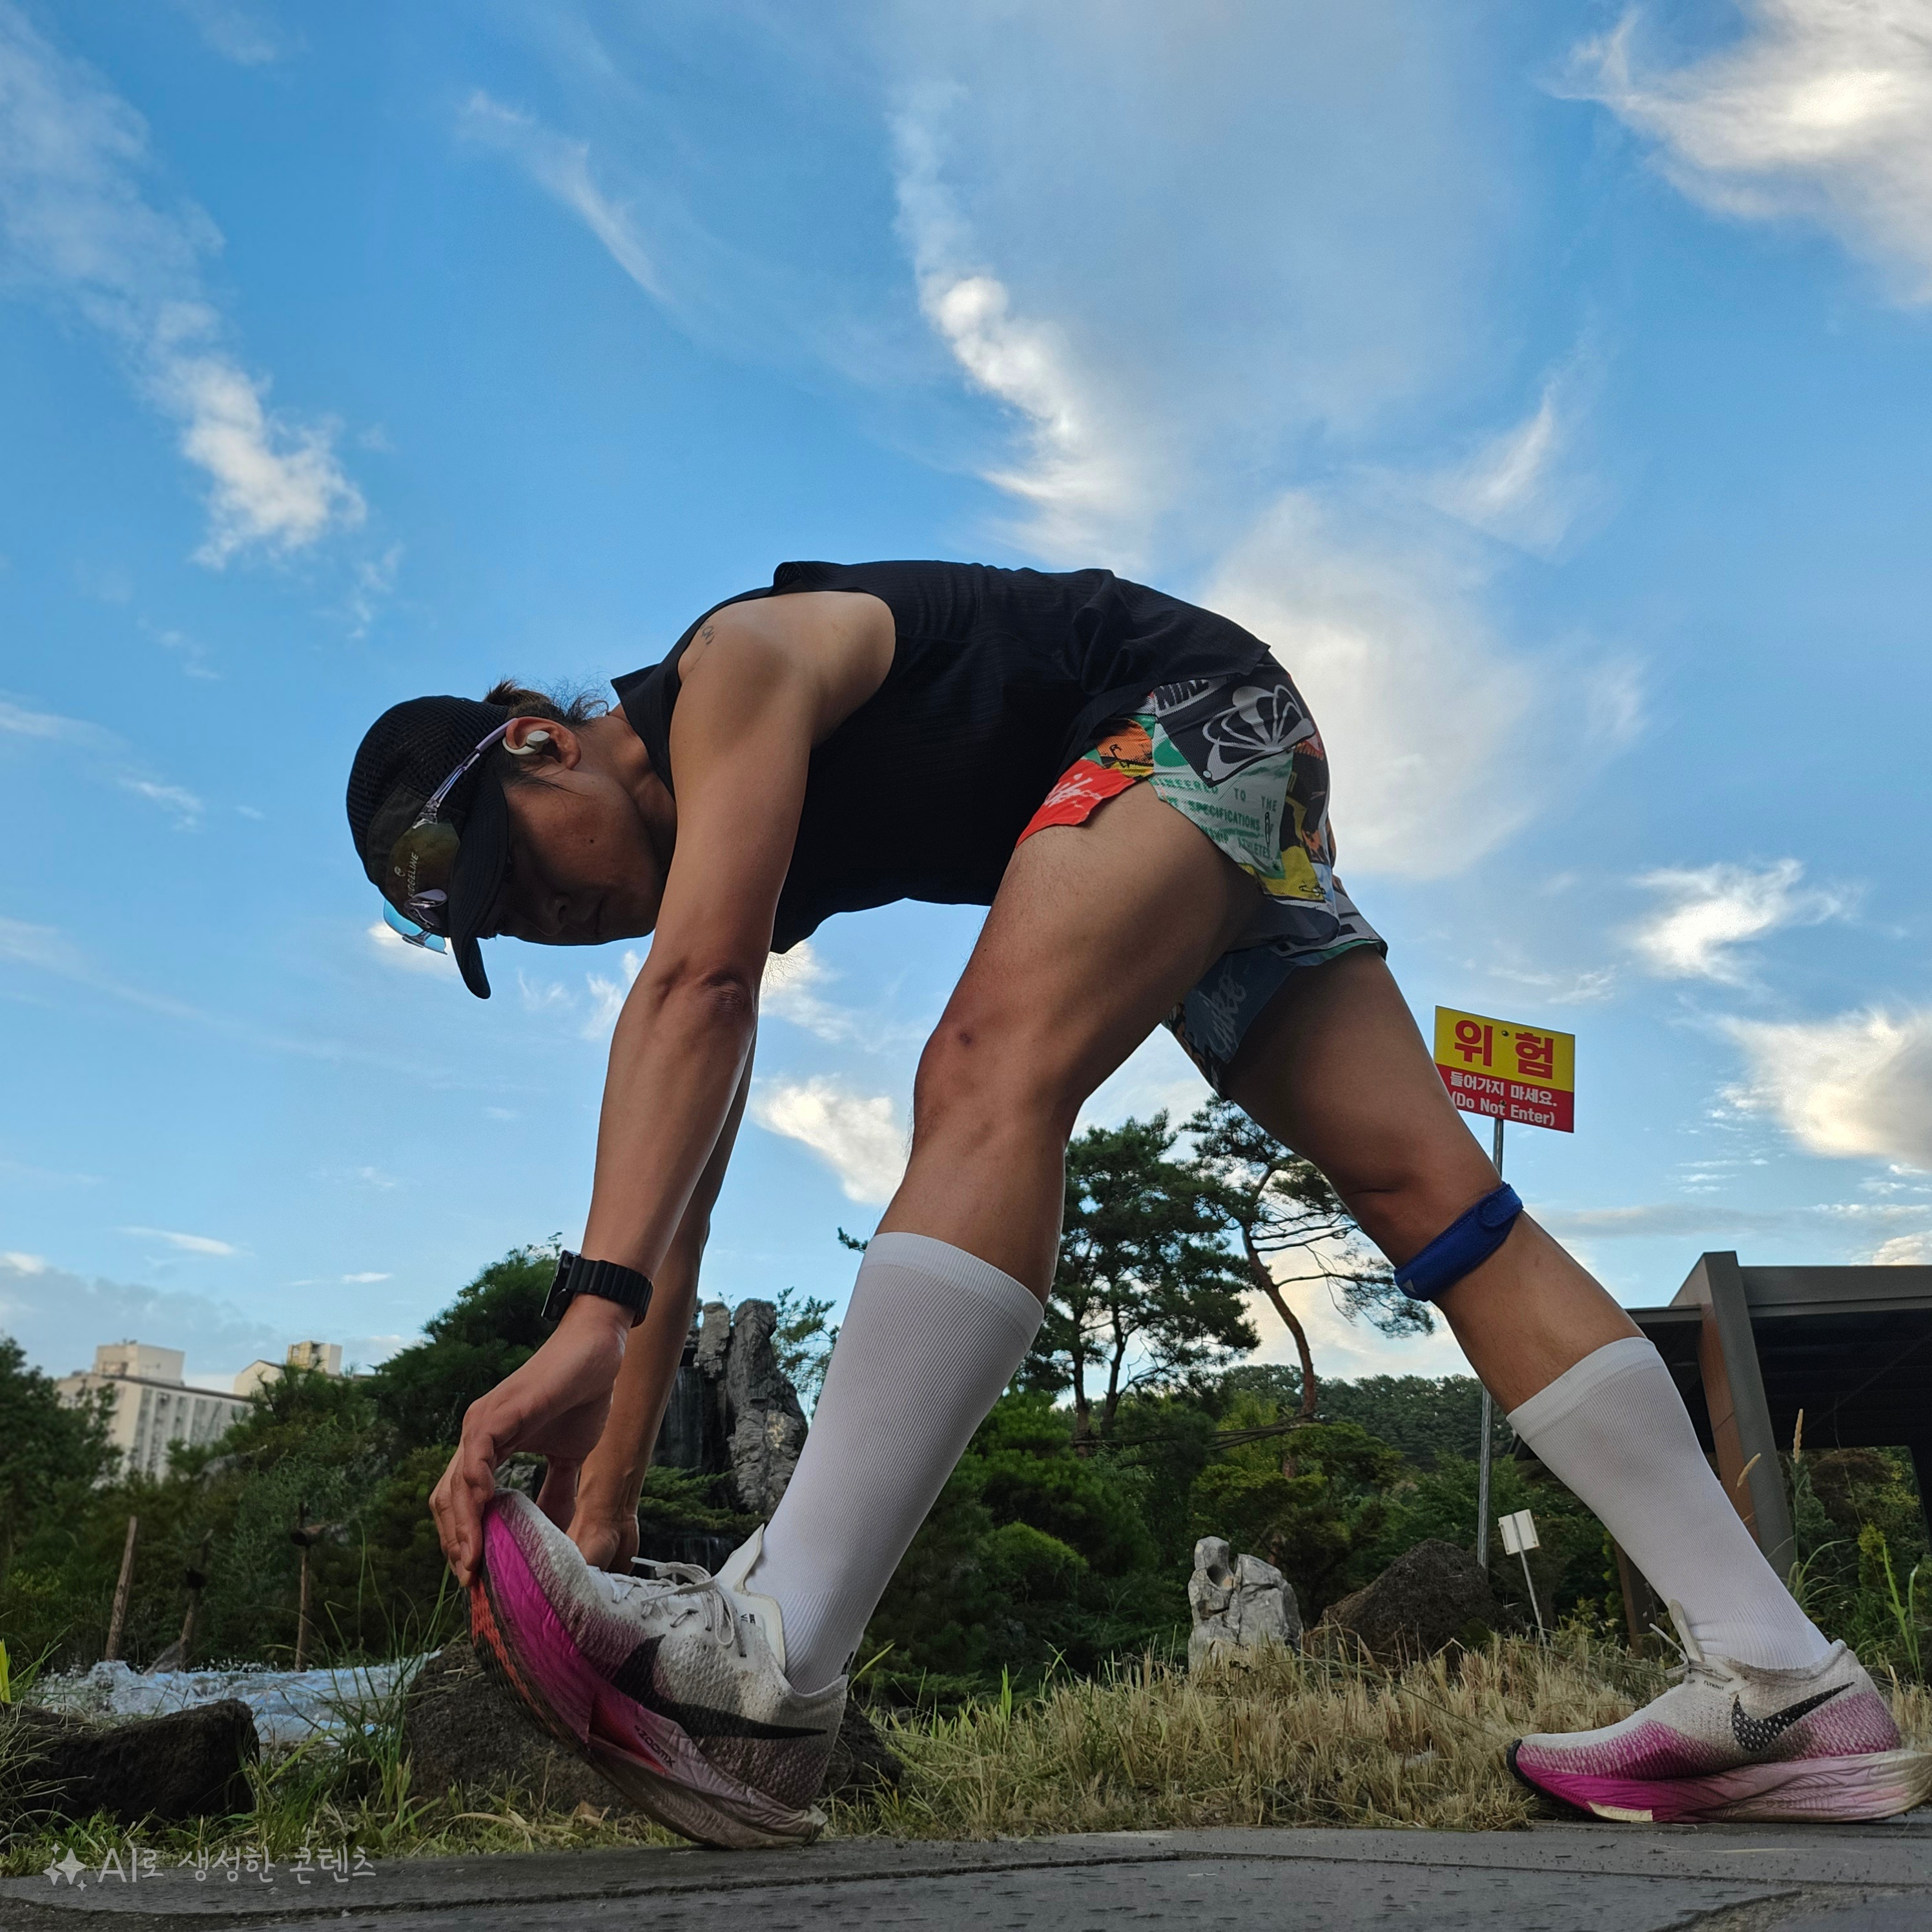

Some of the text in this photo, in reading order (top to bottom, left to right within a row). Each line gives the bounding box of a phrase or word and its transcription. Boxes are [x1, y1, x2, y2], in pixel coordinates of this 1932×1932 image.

[1187, 800, 1260, 832] SPECIFICATIONS
[1234, 787, 1246, 802] TO
[1261, 796, 1278, 812] THE
[1450, 1071, 1557, 1107] 들어가지 마세요.
[1452, 1091, 1556, 1126] (Do Not Enter)
